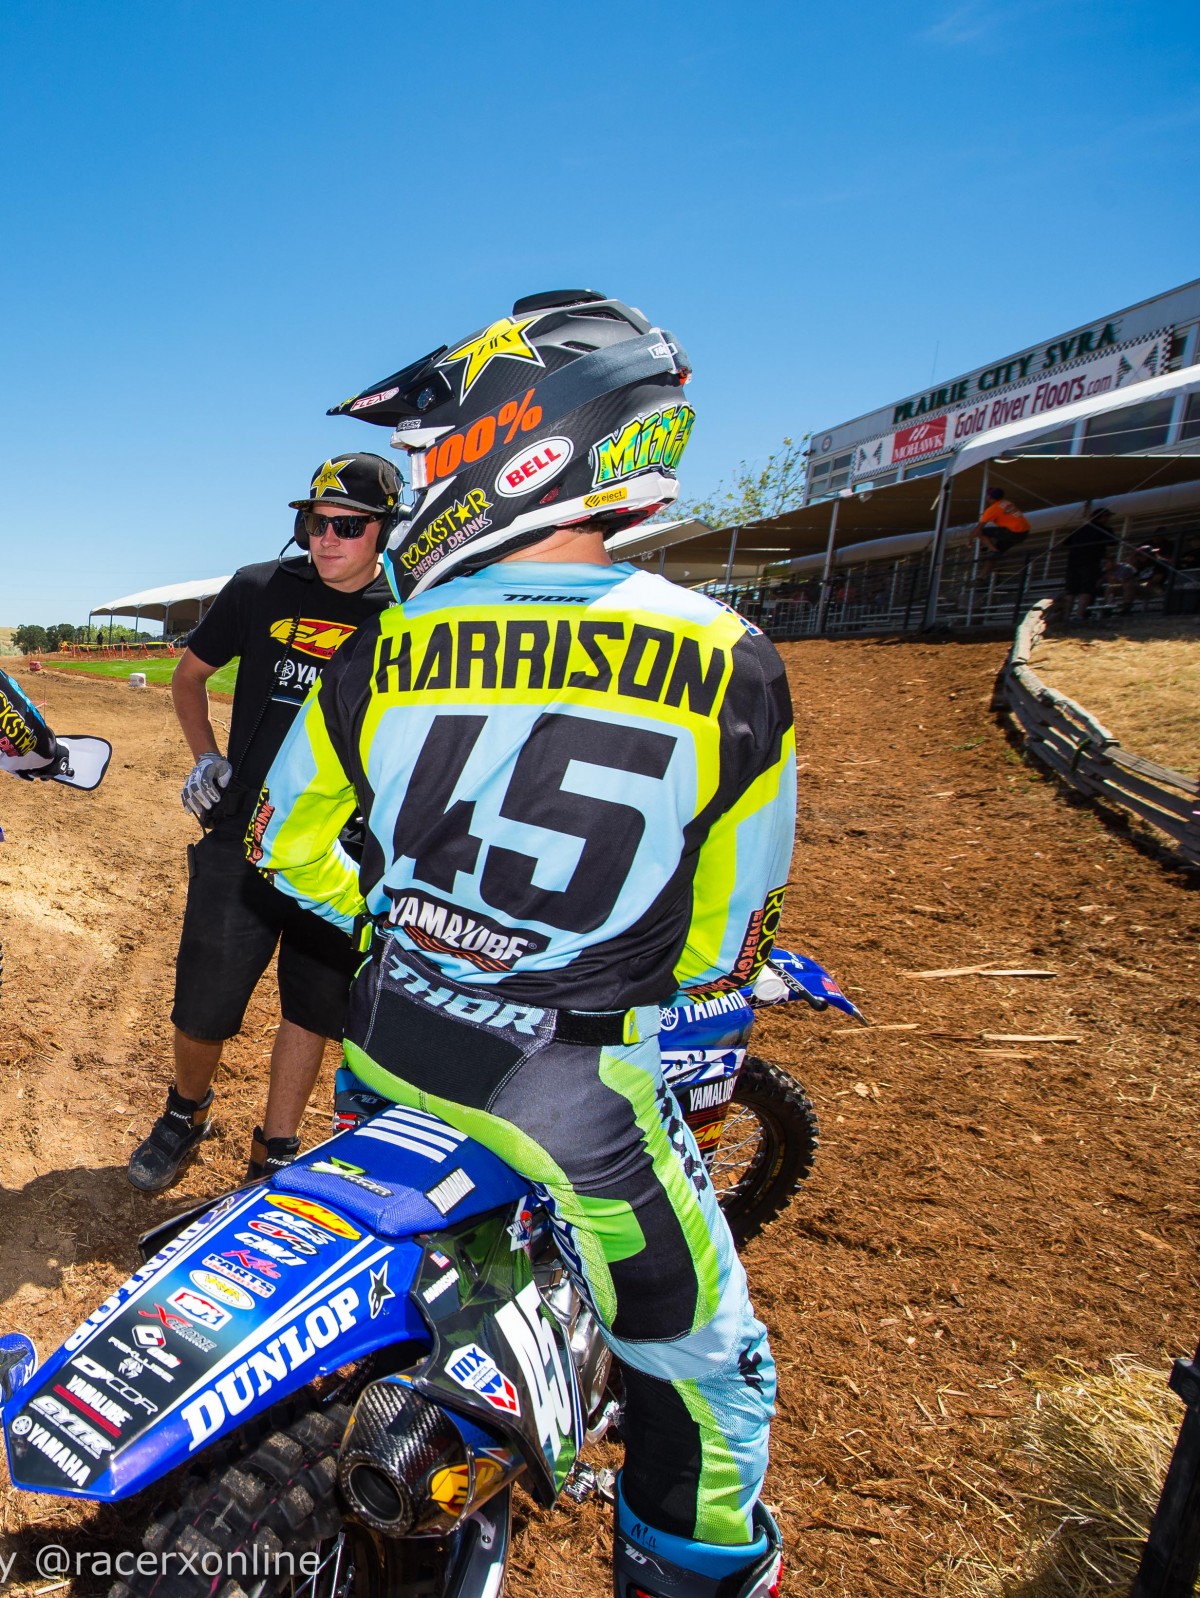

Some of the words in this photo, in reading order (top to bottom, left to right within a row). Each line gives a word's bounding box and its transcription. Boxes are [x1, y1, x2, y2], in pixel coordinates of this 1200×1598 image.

[892, 379, 970, 424] PRAIRIE
[978, 354, 1035, 391] CITY
[1042, 322, 1117, 369] SVRA
[955, 404, 988, 439] Gold
[988, 396, 1030, 428] River
[1031, 374, 1113, 414] Floors.com
[424, 387, 543, 485] 100%
[893, 433, 946, 460] MOHAWK
[505, 447, 562, 488] BELL
[602, 490, 622, 502] eject
[412, 546, 445, 581] ENERGY
[448, 516, 488, 548] DRINK
[502, 593, 590, 603] THOR
[375, 619, 727, 718] HARRISON
[392, 711, 679, 935] 45
[389, 897, 530, 960] YAMALUBE
[733, 910, 765, 981] ENERGY
[387, 953, 545, 1037] THOR
[774, 967, 804, 994] ARC
[169, 1109, 192, 1121] thor
[266, 1157, 292, 1167] thor
[203, 1260, 270, 1298] UNLIMITED
[208, 1254, 276, 1294] PARTS
[177, 1294, 222, 1325] 100%
[107, 1336, 176, 1384] REKLUSE
[179, 1286, 360, 1452] DUNLOP
[450, 1347, 487, 1383] MX
[494, 1280, 573, 1462] 45
[29, 1395, 116, 1453] GYTR
[65, 1374, 131, 1428] YAMALUBE
[28, 1422, 92, 1487] YAMAHA
